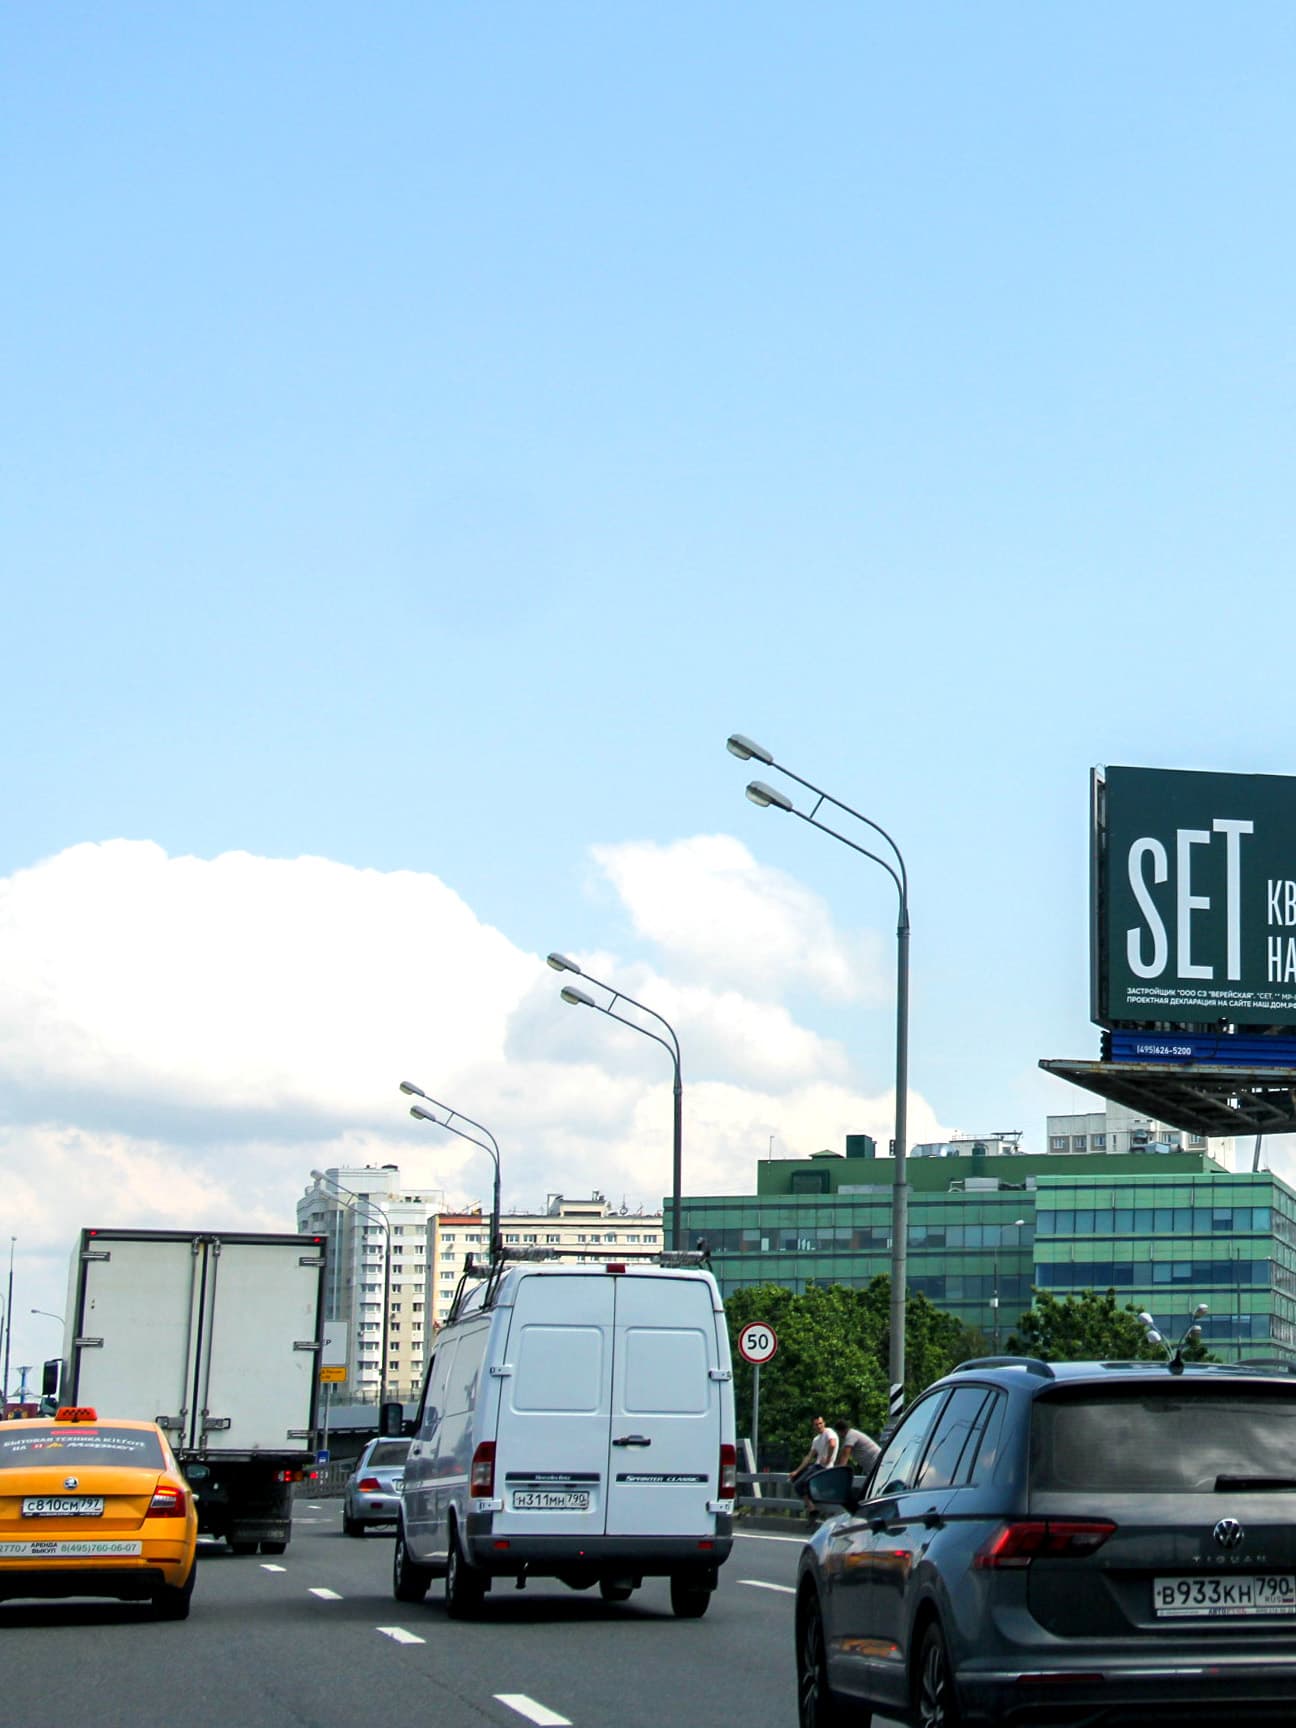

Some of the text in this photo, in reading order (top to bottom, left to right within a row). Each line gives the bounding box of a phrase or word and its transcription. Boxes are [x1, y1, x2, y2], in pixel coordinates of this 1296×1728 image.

[1126, 818, 1254, 980] SET
[1127, 987, 1176, 996] ЗАСТРОЙЩИК
[1127, 996, 1169, 1004] ПРОЕКТНАЯ
[1170, 997, 1216, 1006] ДЕКЛАРАЦИЯ
[1229, 999, 1251, 1007] САЙТЕ
[747, 1333, 769, 1350] 50
